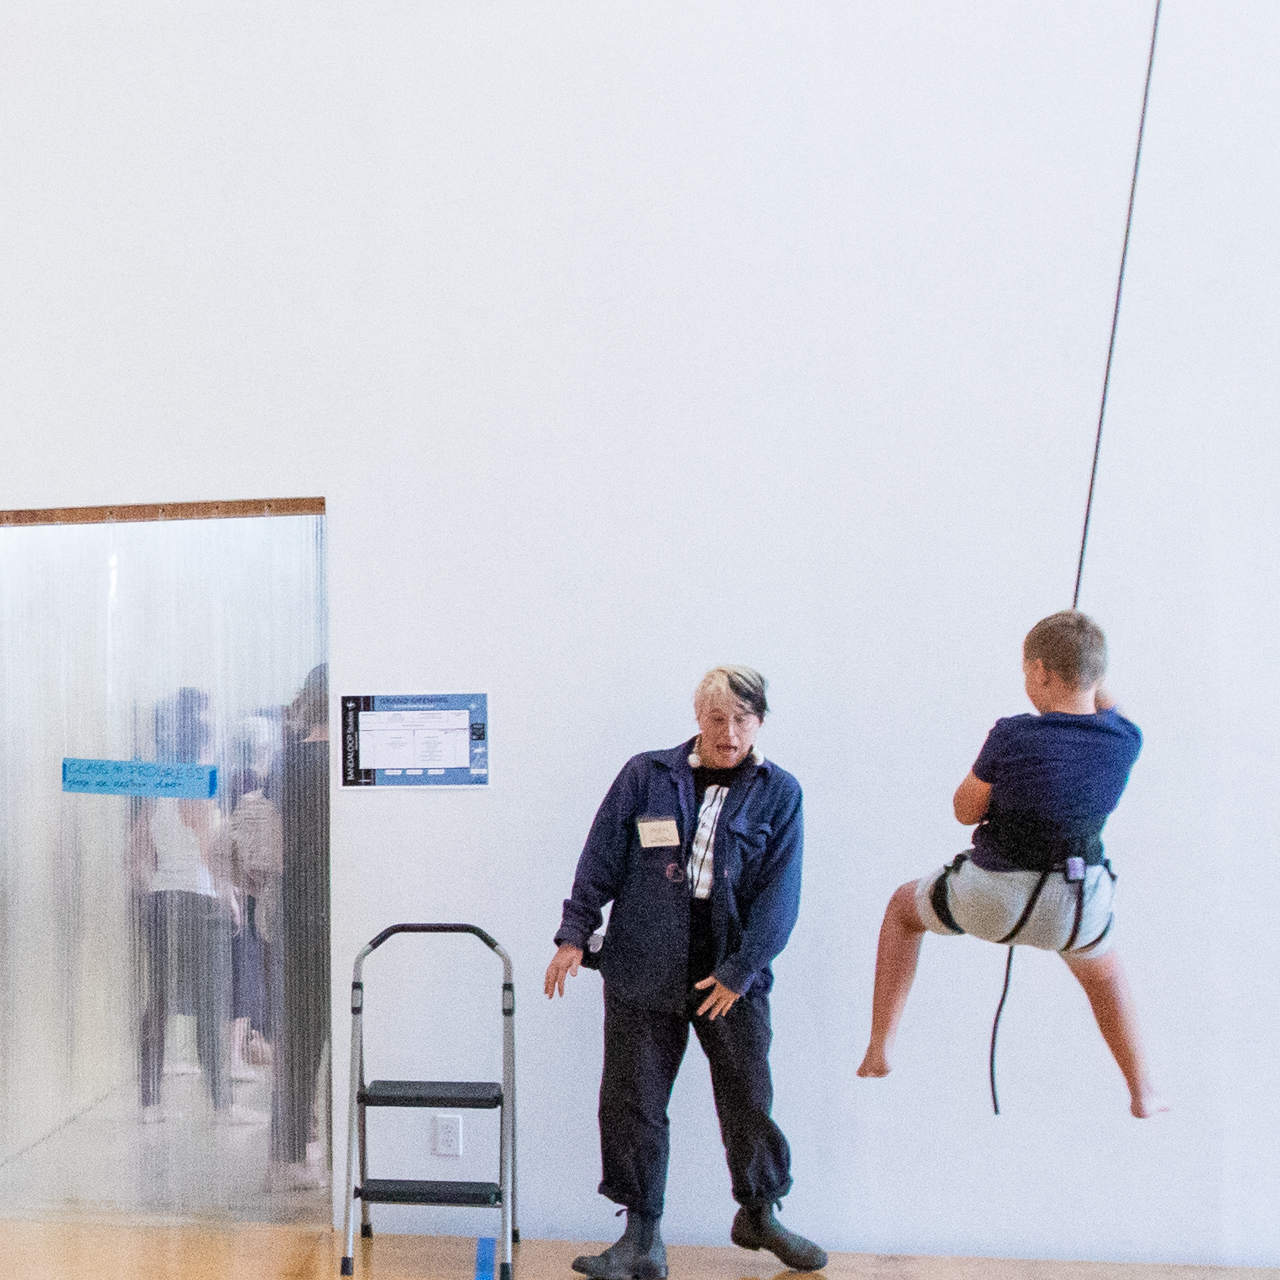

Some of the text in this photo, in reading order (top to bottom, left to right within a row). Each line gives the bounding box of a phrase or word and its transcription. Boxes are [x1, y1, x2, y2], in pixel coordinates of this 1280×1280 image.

[68, 762, 108, 775] CLASS
[130, 765, 204, 780] PROGRESS
[346, 734, 355, 781] BANDALOOP
